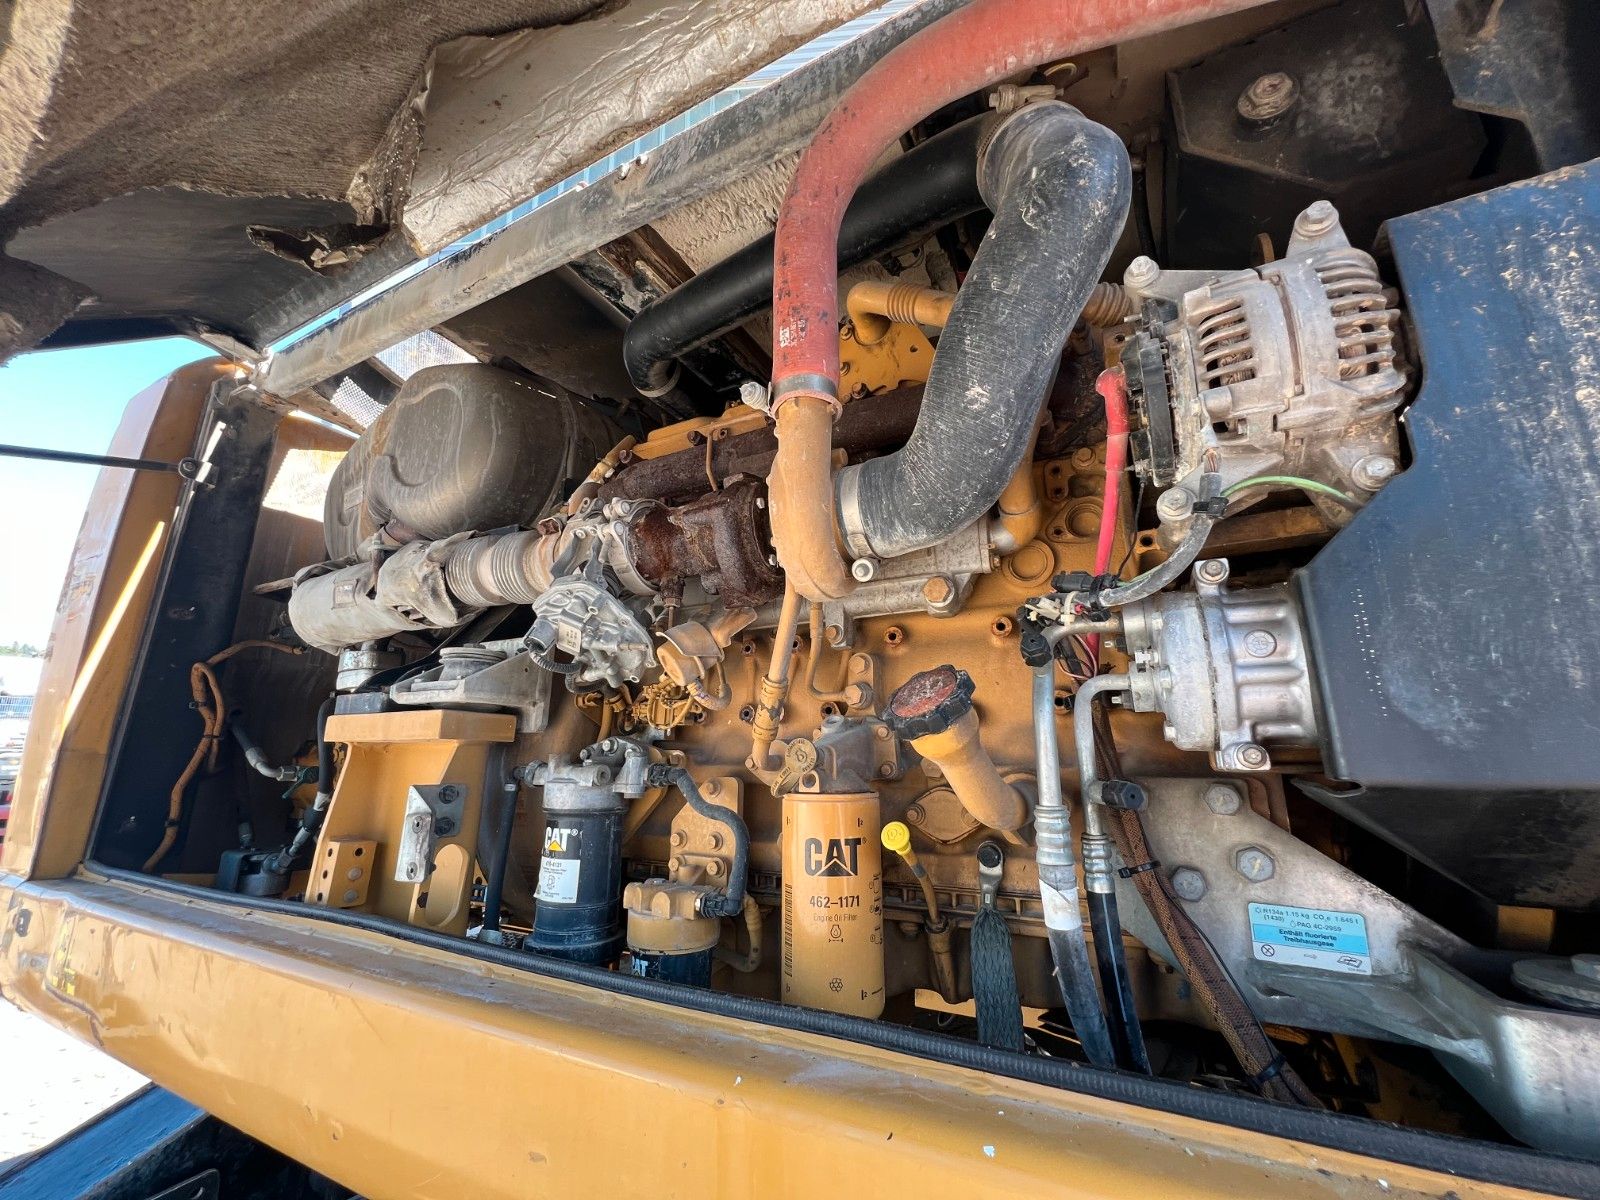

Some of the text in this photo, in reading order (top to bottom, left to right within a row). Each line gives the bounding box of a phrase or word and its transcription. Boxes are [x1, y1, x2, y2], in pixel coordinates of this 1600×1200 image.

[544, 827, 571, 852] CAT
[805, 838, 862, 876] CAT
[809, 895, 860, 909] 462-1171
[813, 913, 858, 923] Engine Oil Filter
[1279, 928, 1338, 941] Enthält fluorierte
[1283, 935, 1335, 948] Treibhausgase
